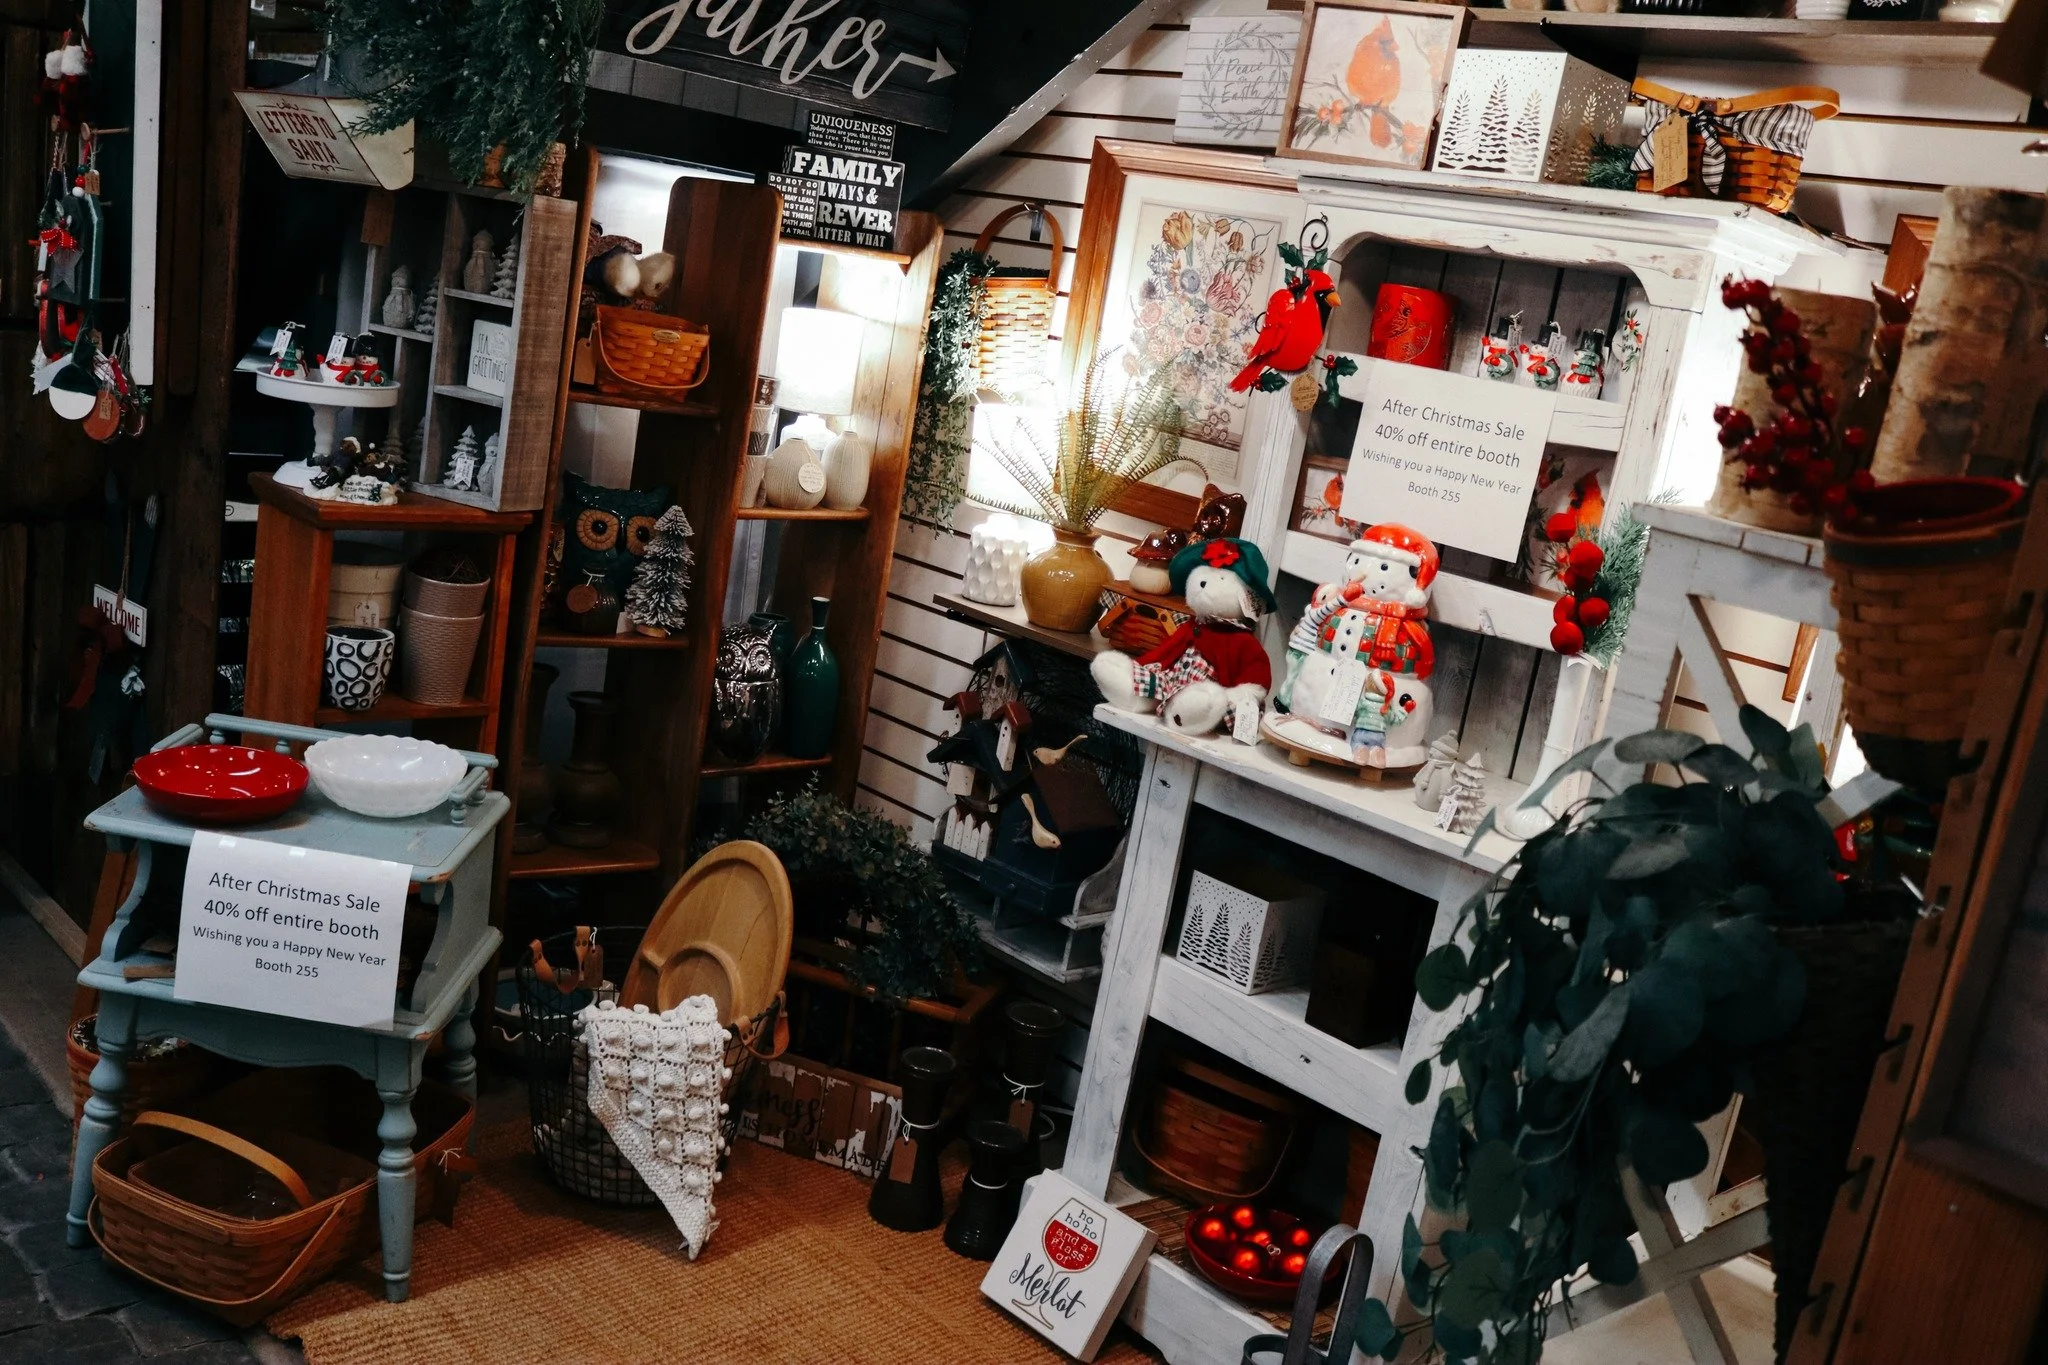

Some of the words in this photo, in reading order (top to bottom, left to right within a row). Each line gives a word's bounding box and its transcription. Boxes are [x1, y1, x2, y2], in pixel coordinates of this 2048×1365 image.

[1225, 58, 1264, 80] Peace
[1221, 76, 1263, 103] Earth
[257, 111, 318, 137] LETTERS
[313, 116, 337, 140] TO
[810, 124, 825, 133] Today
[811, 113, 893, 136] UNIQUENESS
[287, 138, 340, 165] SANTA
[843, 137, 860, 145] There
[770, 175, 782, 183] DO
[786, 178, 802, 186] NOT
[792, 151, 901, 187] FAMILY
[770, 183, 798, 193] HERE
[801, 188, 817, 196] THE
[798, 196, 815, 205] LEAD,
[819, 180, 864, 202] LWAYS
[866, 187, 878, 205] &
[784, 203, 814, 212] NSTEAD
[792, 212, 813, 220] THERE
[818, 201, 893, 233] REVER
[793, 228, 810, 236] TRAIL
[814, 226, 851, 243] ATTER
[856, 232, 886, 247] WHAT
[1382, 398, 1418, 417] After
[1422, 406, 1491, 433] Christmas
[1495, 422, 1525, 440] Sale
[1375, 424, 1404, 442] 40%
[1408, 431, 1429, 447] off
[1431, 439, 1473, 457] entire
[1477, 445, 1520, 468] booth
[1363, 448, 1402, 469] Wishing
[1404, 460, 1423, 472] you
[1425, 466, 1431, 474] a
[1435, 466, 1467, 485] Happy
[1470, 474, 1494, 488] New
[1497, 480, 1522, 494] Year
[1408, 481, 1439, 498] Booth
[1441, 489, 1461, 503] 255
[209, 872, 252, 892] After
[257, 880, 340, 907] Christmas
[345, 894, 380, 913] Sale
[204, 900, 240, 918] 40%
[245, 907, 269, 922] off
[273, 914, 323, 931] entire
[329, 918, 379, 940] booth
[193, 926, 242, 946] Wishing
[246, 937, 268, 948] you
[272, 941, 279, 949] a
[283, 940, 322, 958] Happy
[326, 947, 354, 961] New
[359, 952, 386, 966] Year
[255, 958, 292, 973] Booth
[296, 965, 319, 978] 255
[1065, 1213, 1080, 1229] ho
[1082, 1224, 1097, 1240] ho
[1079, 1209, 1094, 1225] ho
[1051, 1237, 1084, 1261] glass
[1056, 1228, 1079, 1246] and
[1081, 1243, 1088, 1252] a
[1056, 1252, 1071, 1264] of
[1009, 1252, 1086, 1319] Merlot
